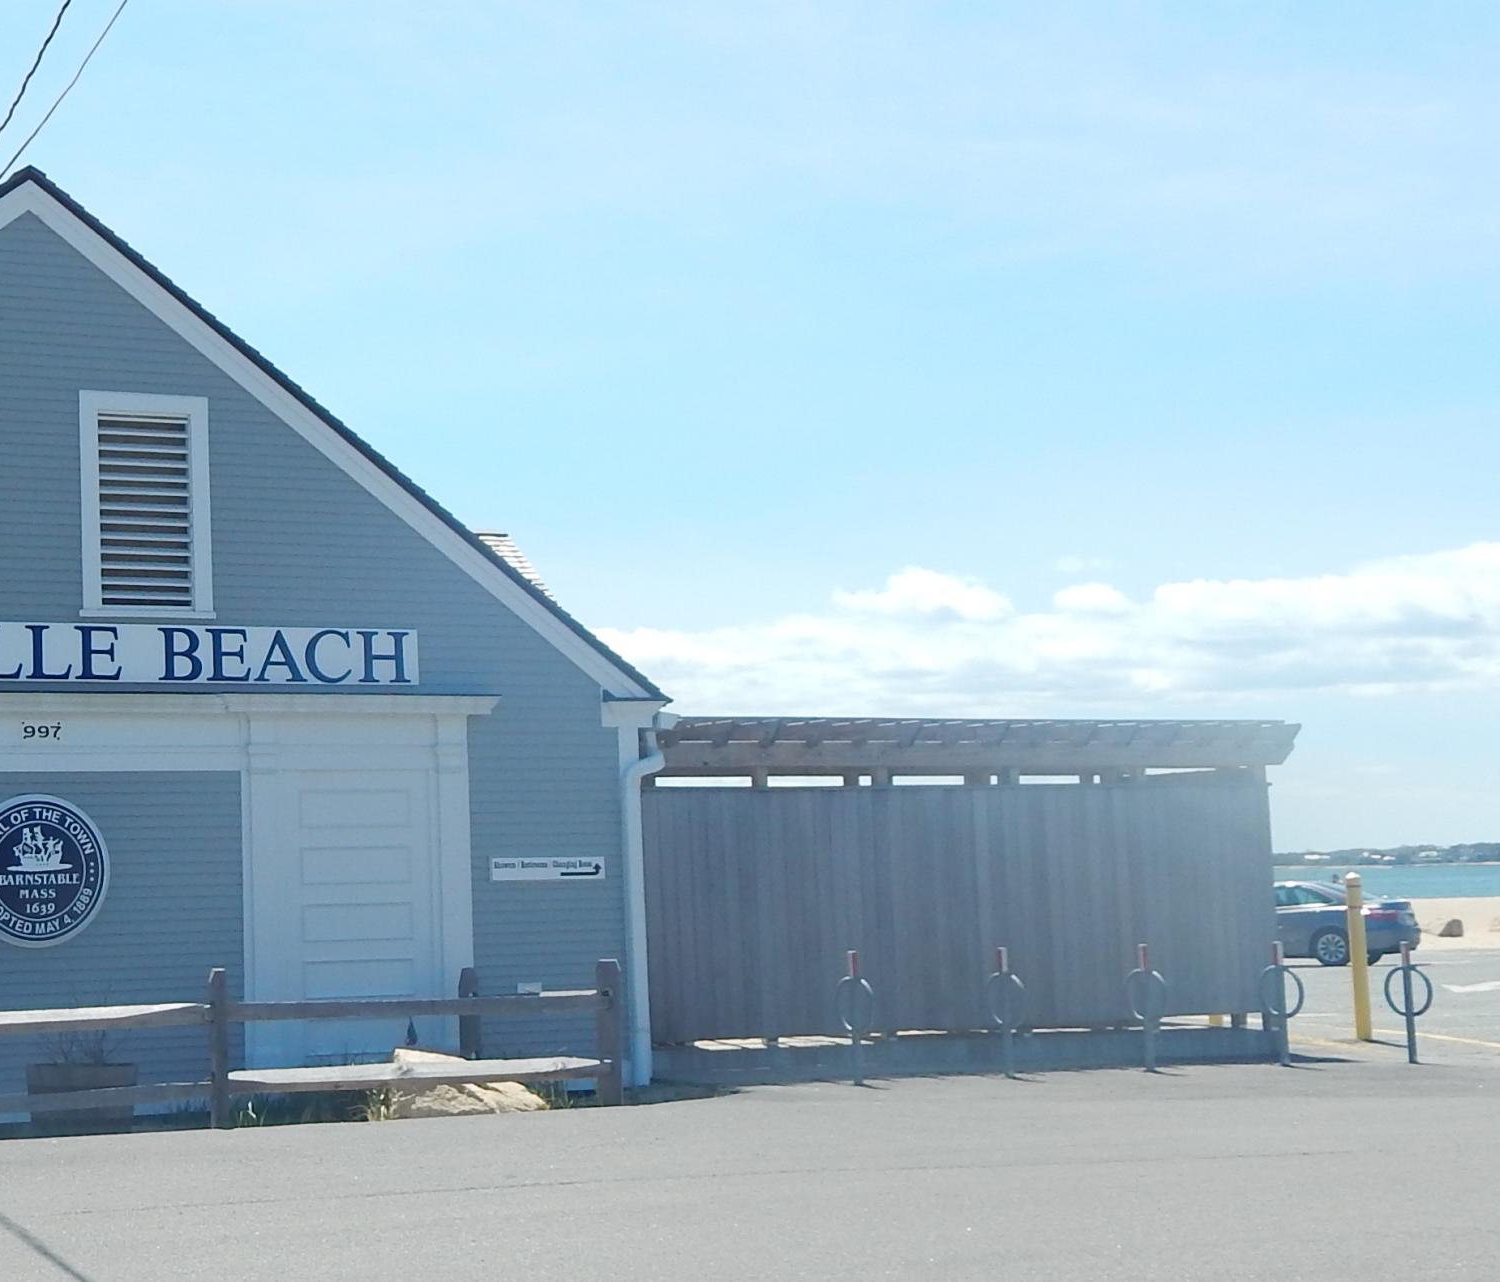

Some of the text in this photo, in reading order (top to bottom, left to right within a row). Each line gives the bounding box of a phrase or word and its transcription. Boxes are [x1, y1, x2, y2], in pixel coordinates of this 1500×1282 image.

[157, 627, 411, 684] BEACH
[23, 725, 62, 738] 997
[10, 809, 30, 825] OF
[33, 808, 62, 823] THE
[64, 818, 95, 855] TOWN
[19, 888, 56, 899] MASS
[26, 902, 56, 916] 1639
[35, 918, 61, 934] MAY
[73, 888, 93, 915] 1889
